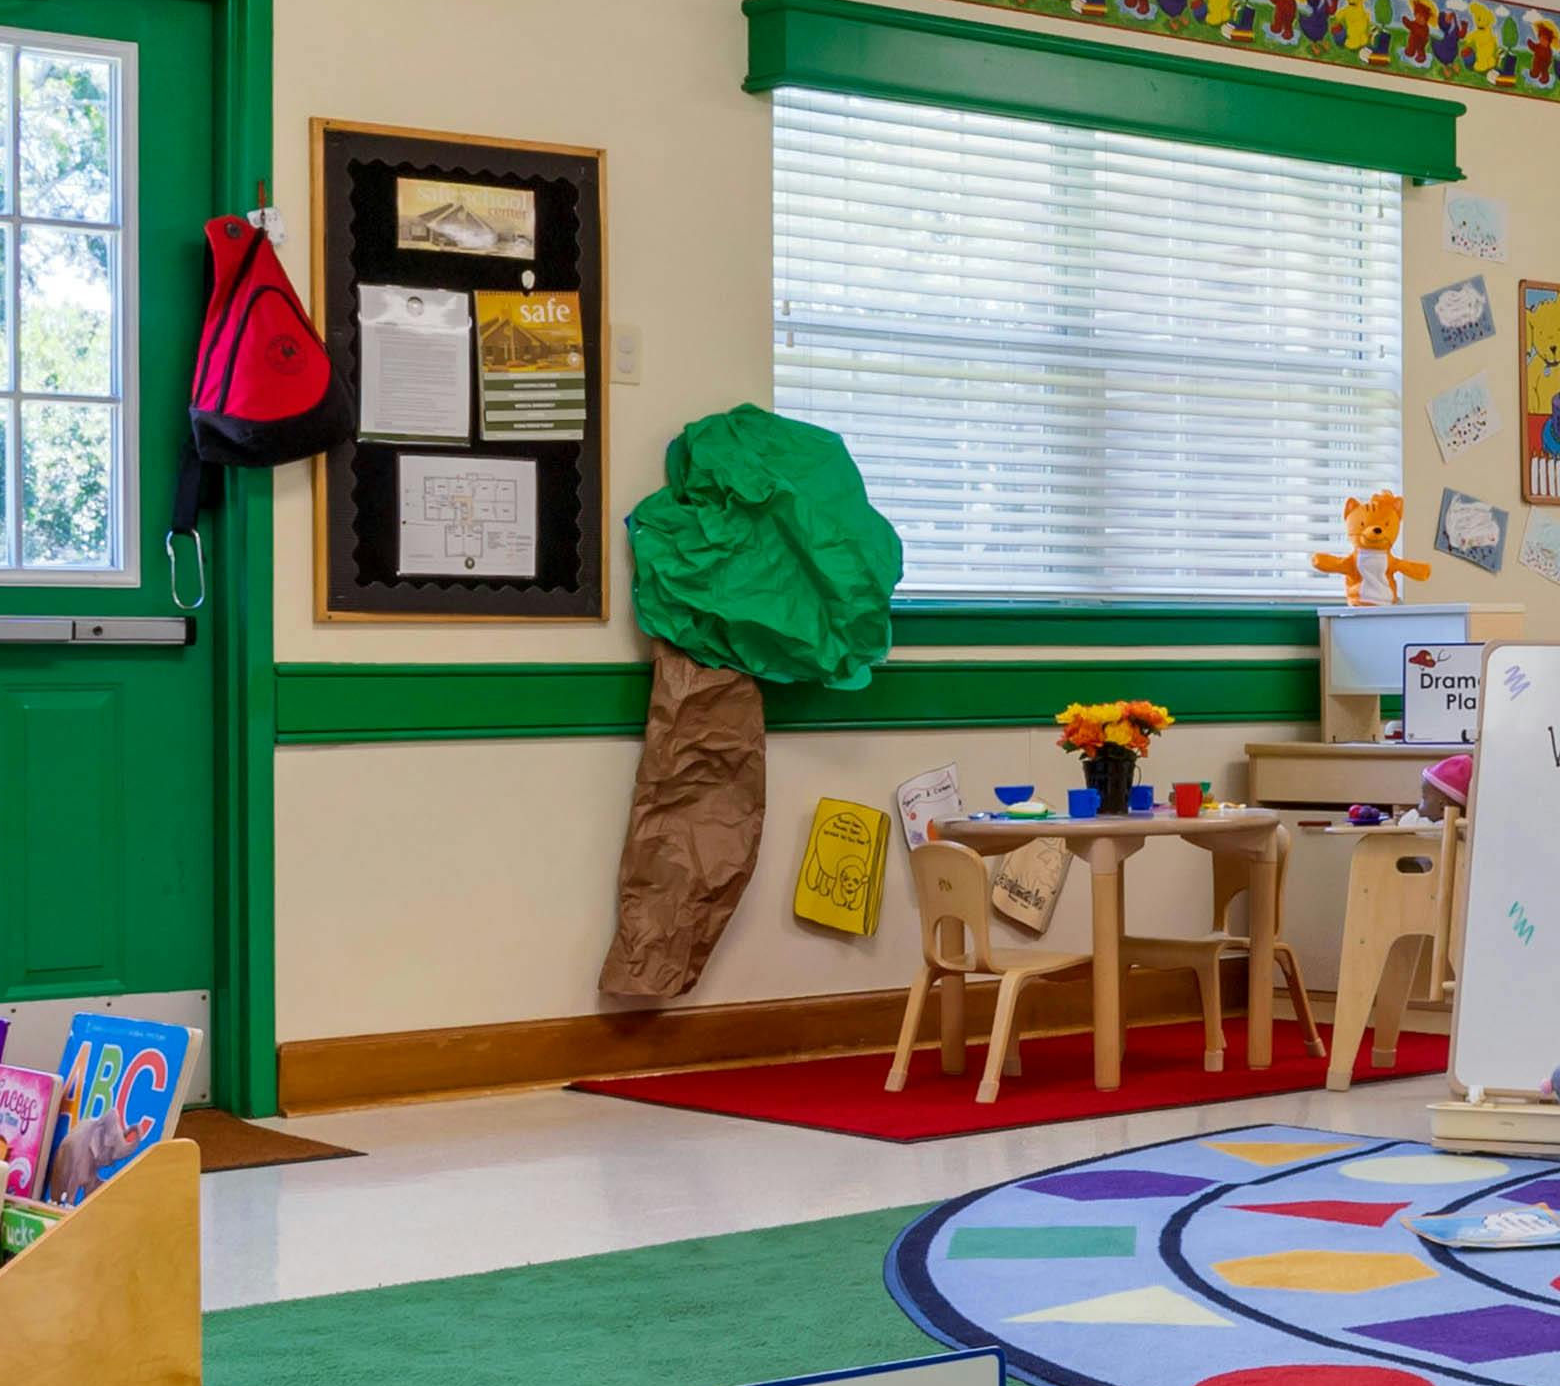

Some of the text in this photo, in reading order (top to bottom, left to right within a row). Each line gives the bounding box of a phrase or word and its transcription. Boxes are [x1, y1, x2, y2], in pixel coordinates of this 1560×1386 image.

[520, 297, 570, 323] safe
[1420, 672, 1480, 690] Dram
[1446, 693, 1477, 710] Pla
[60, 1040, 169, 1144] ABC
